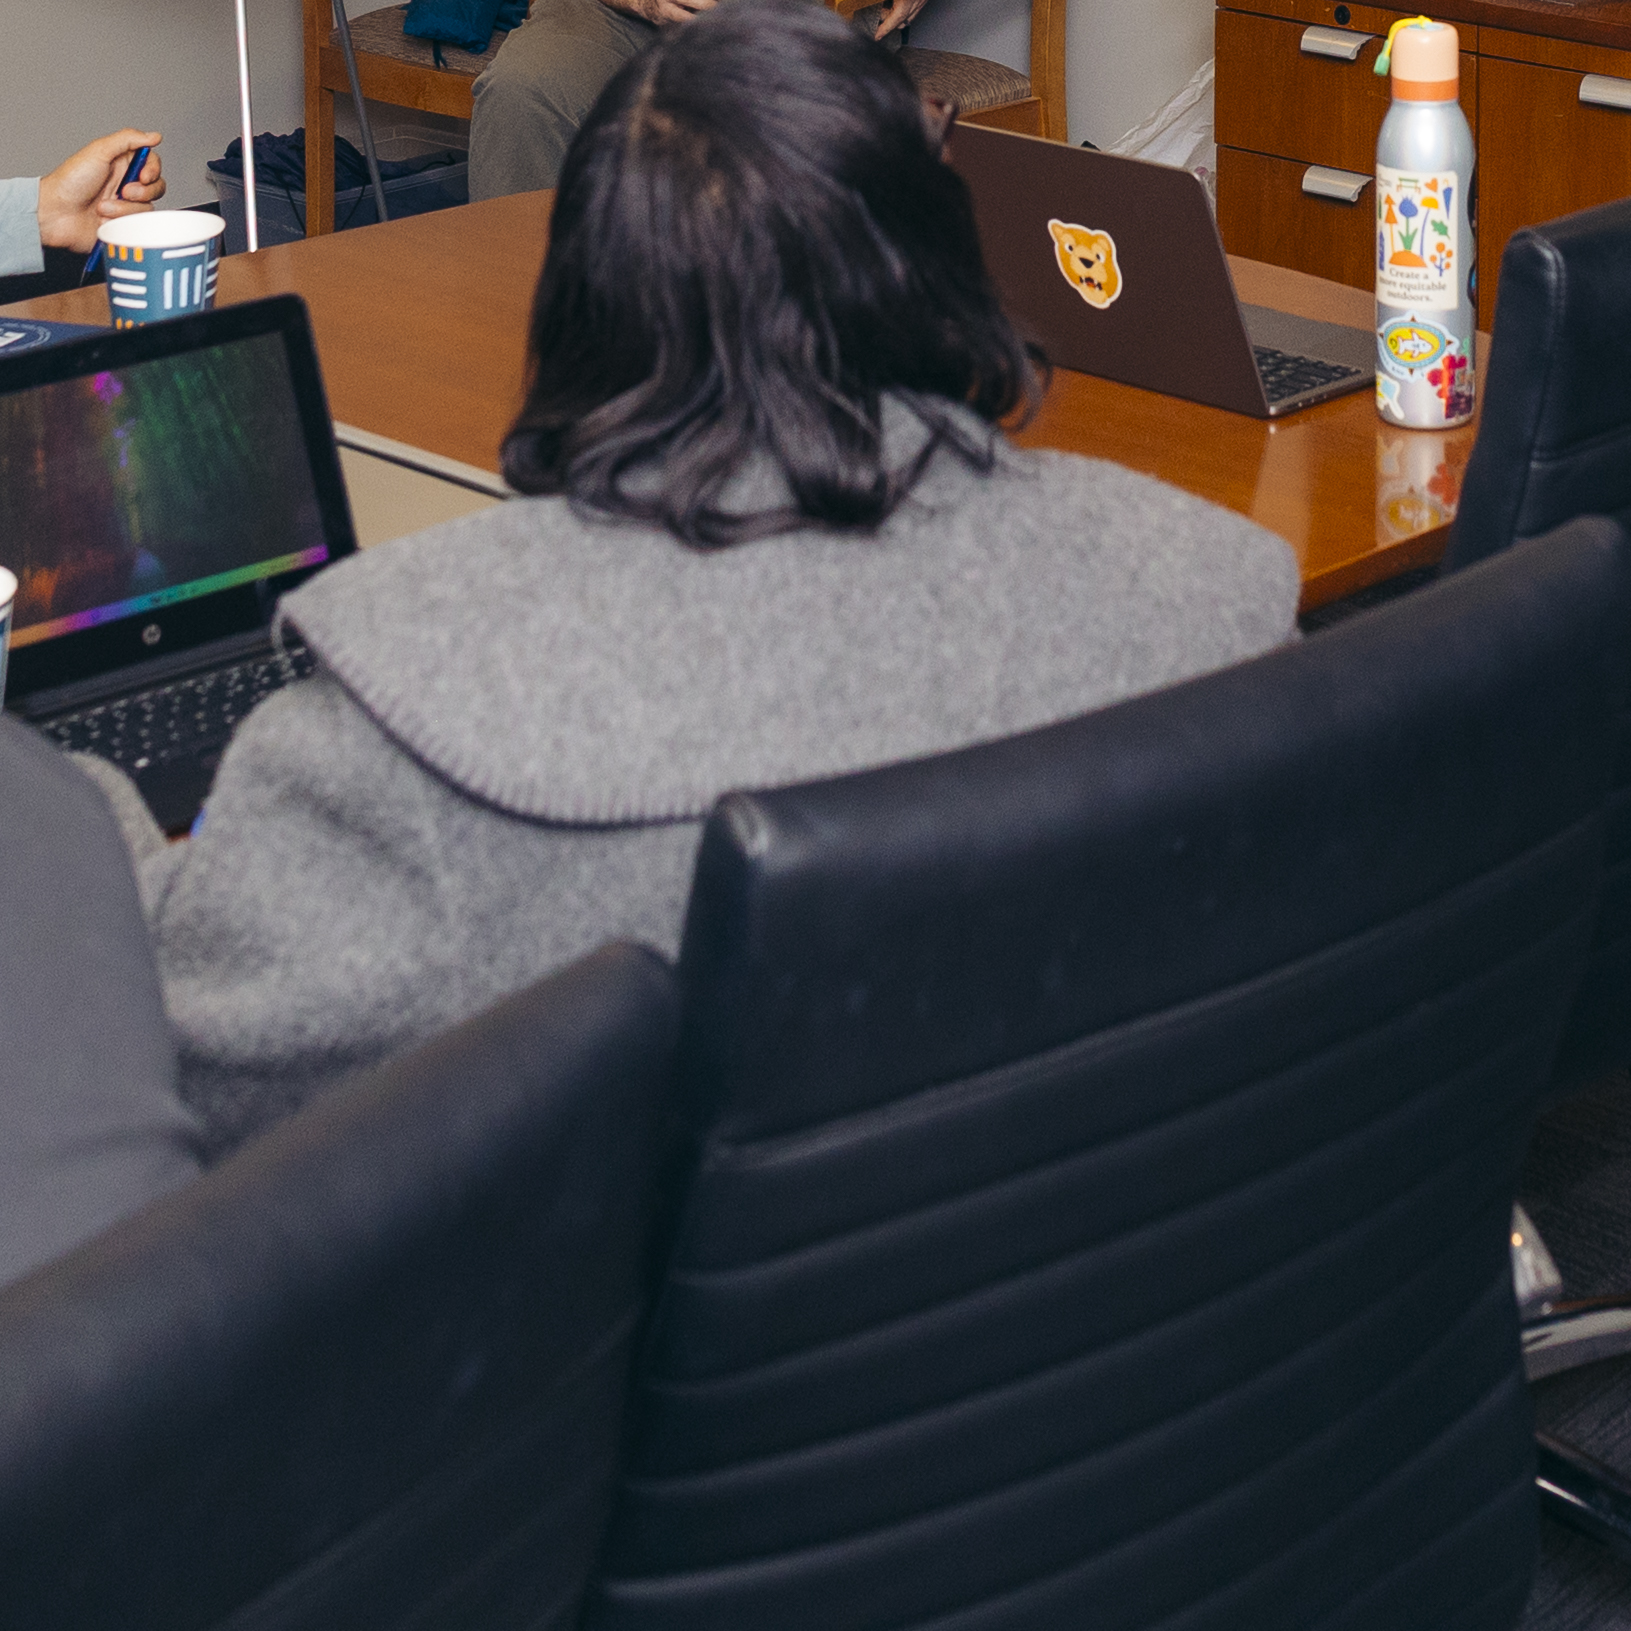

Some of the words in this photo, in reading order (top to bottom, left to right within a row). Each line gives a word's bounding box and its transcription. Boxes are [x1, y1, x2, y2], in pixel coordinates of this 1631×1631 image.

[1389, 268, 1421, 280] Create
[1399, 279, 1447, 291] equitable
[1386, 290, 1434, 303] outdoors.
